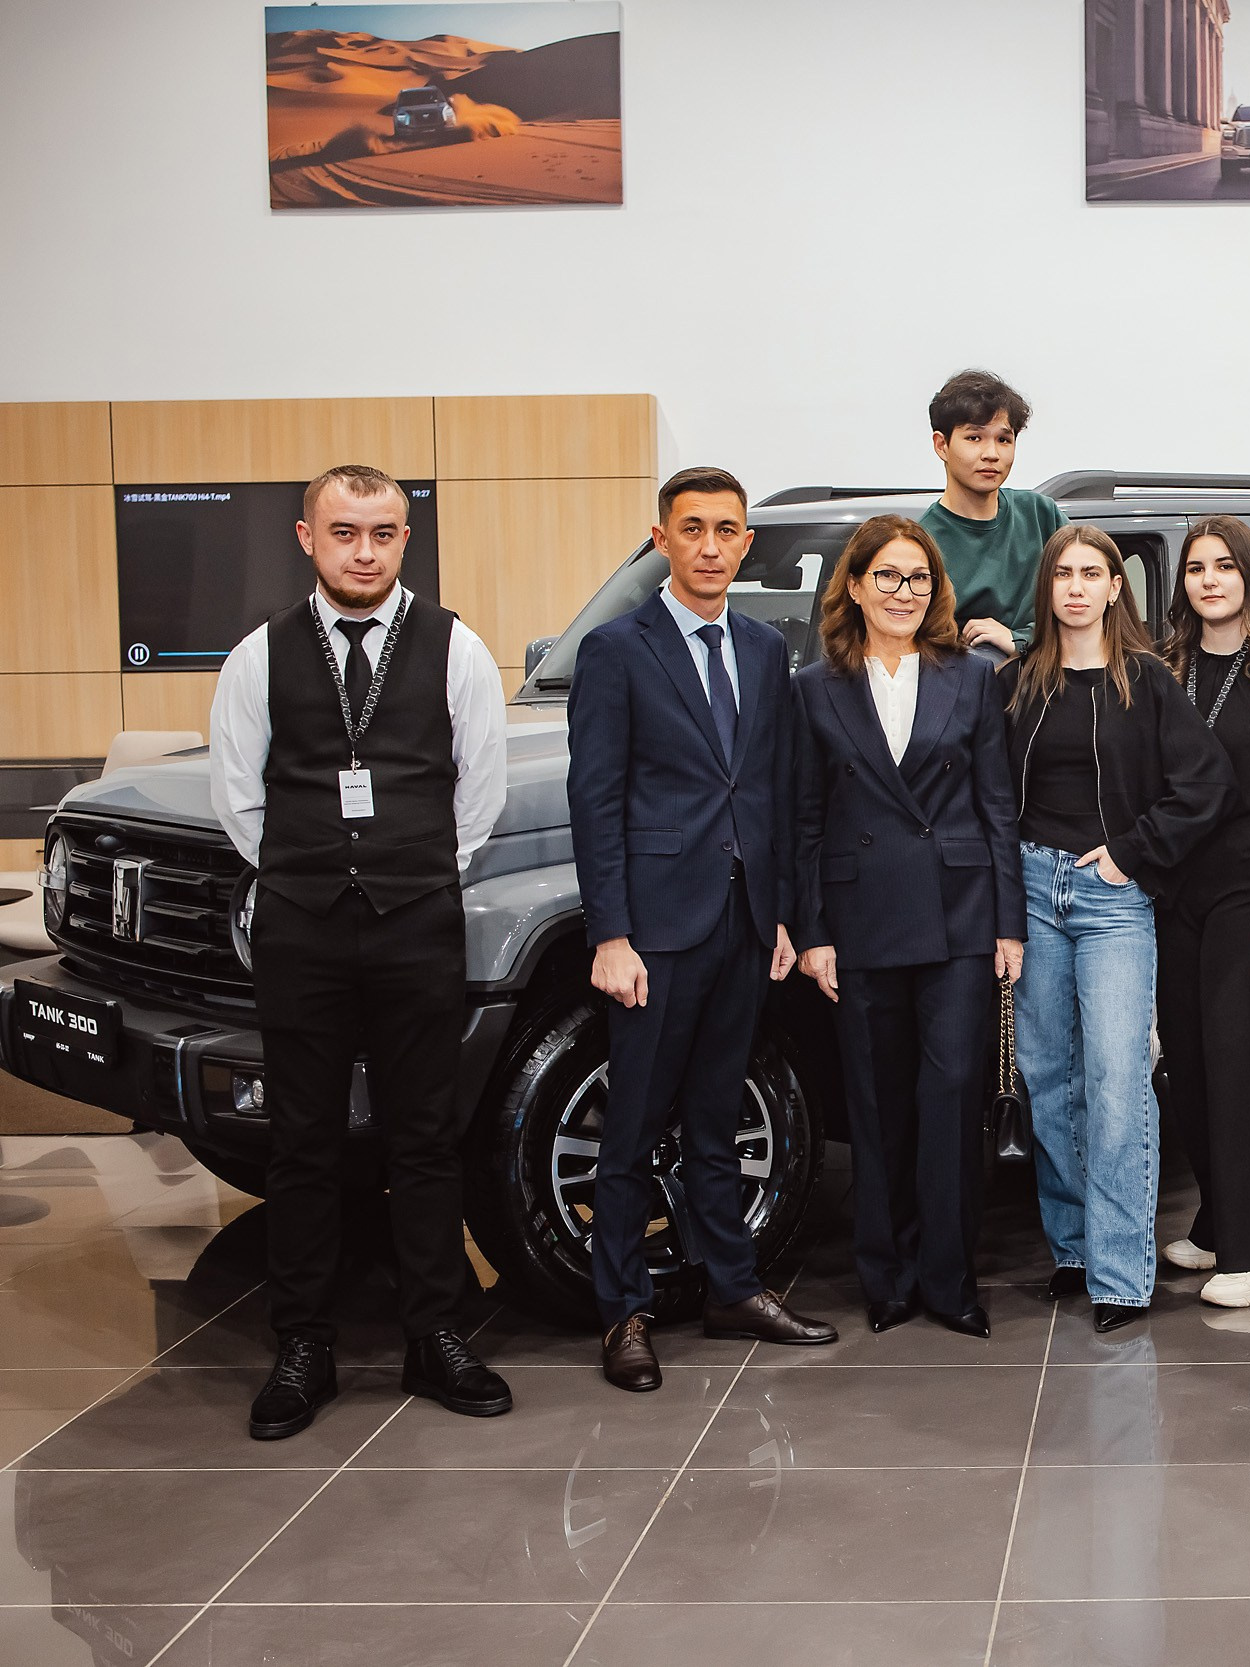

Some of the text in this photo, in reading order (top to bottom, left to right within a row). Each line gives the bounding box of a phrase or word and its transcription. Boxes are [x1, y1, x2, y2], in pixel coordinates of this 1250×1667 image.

[28, 1000, 99, 1036] TANK 300
[86, 1051, 105, 1064] TANK
